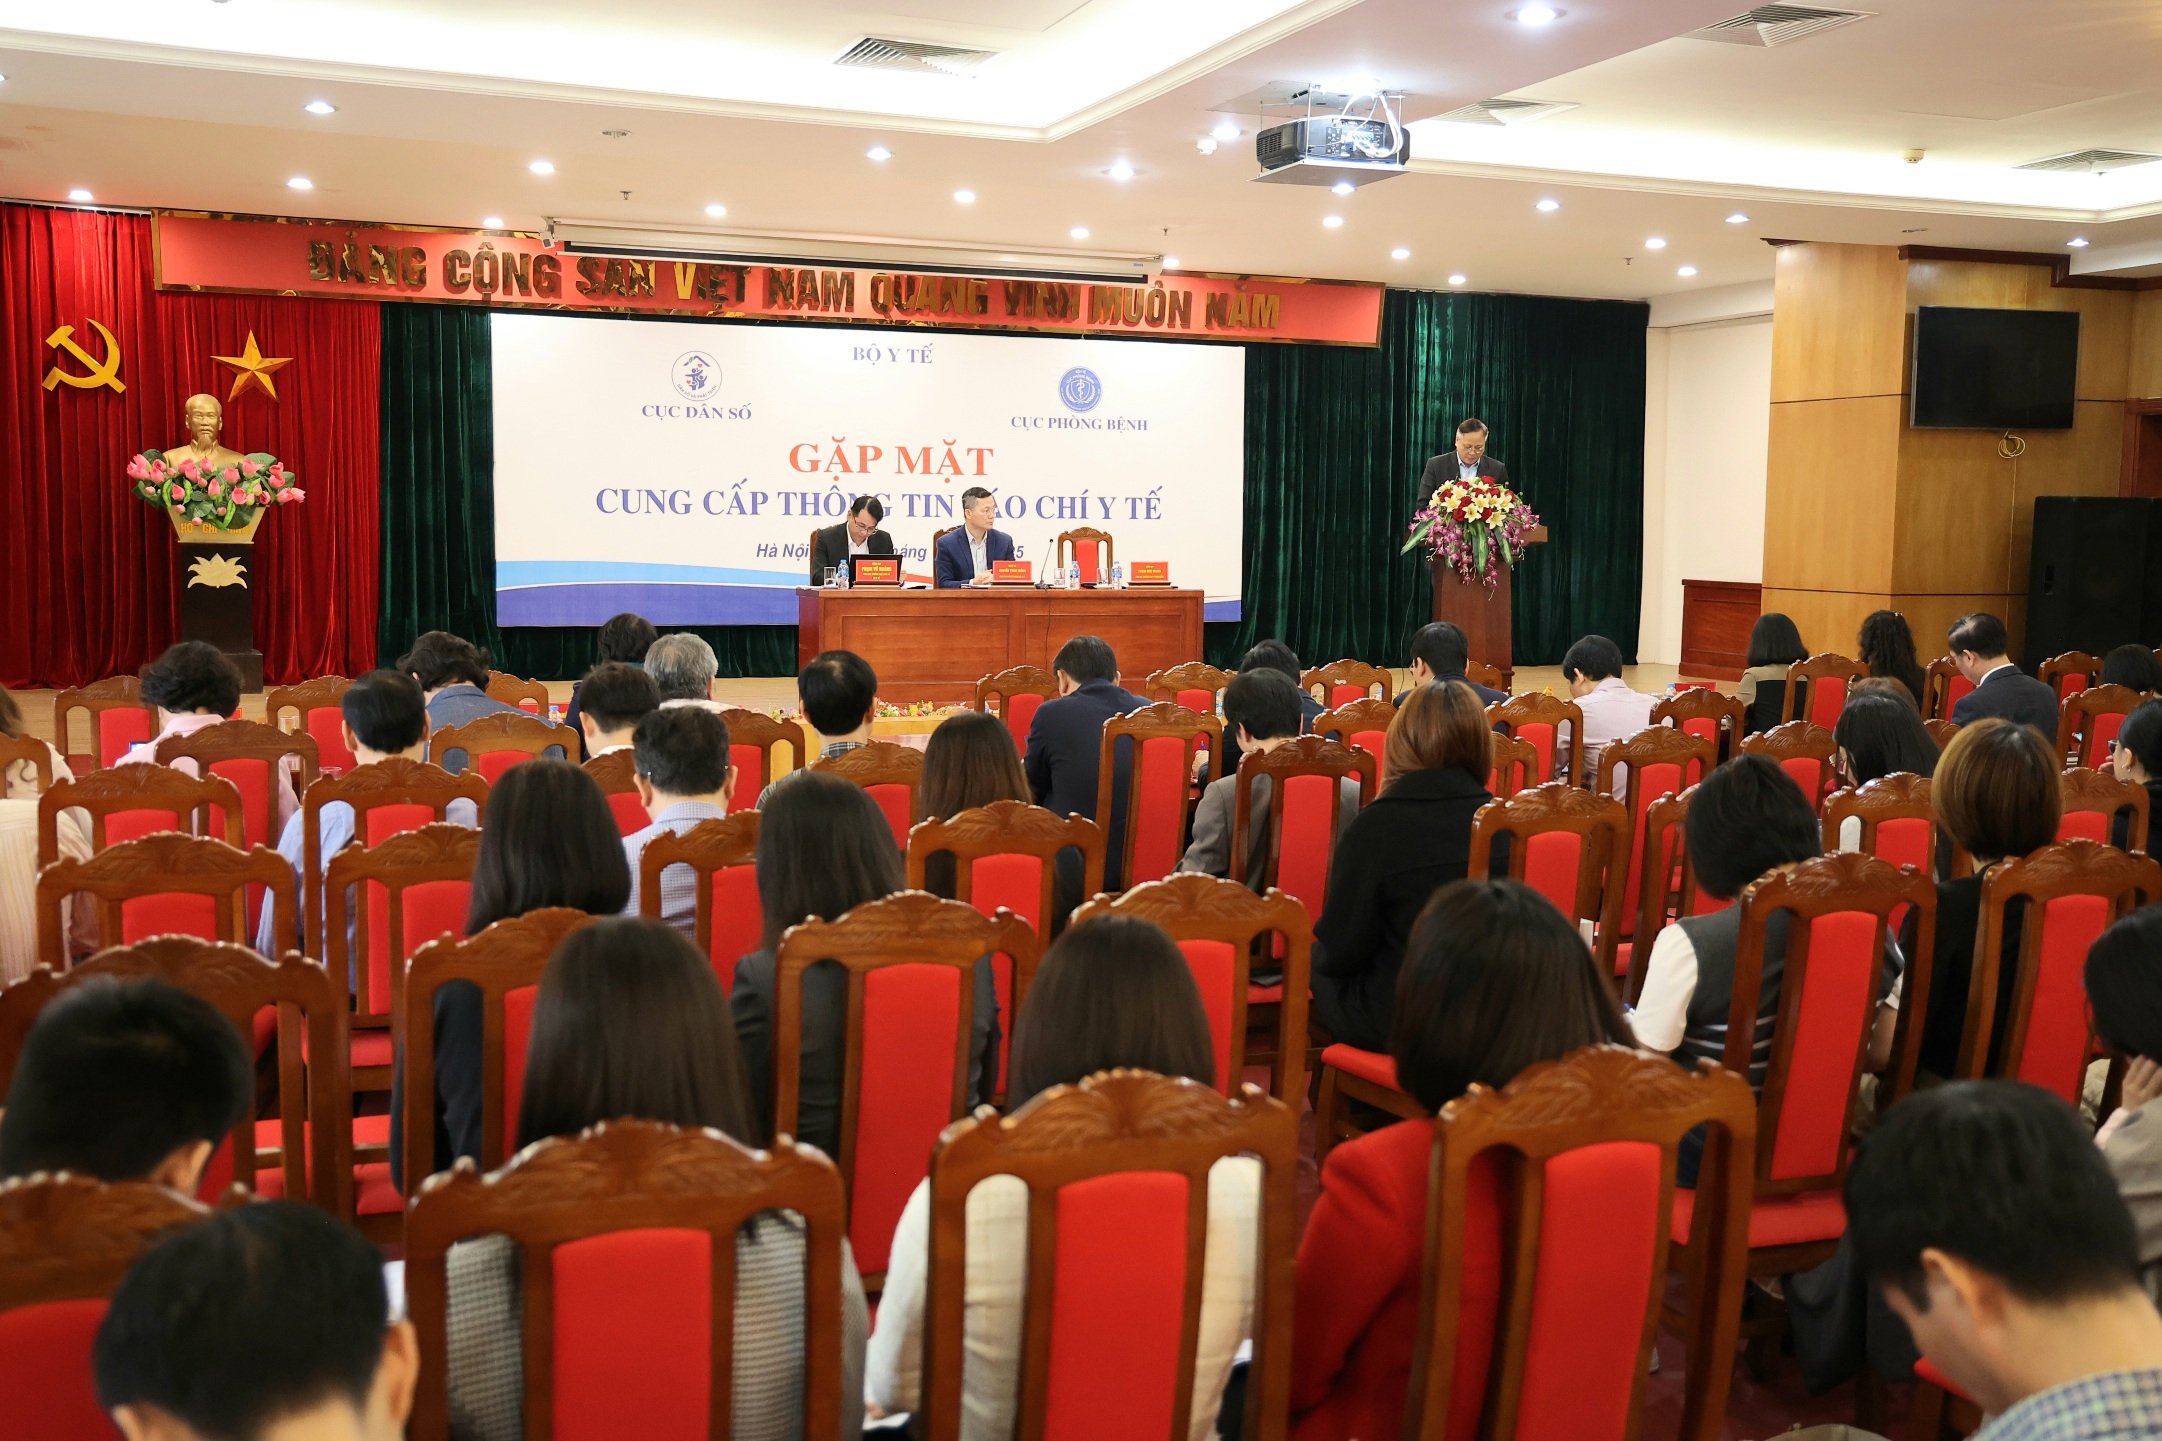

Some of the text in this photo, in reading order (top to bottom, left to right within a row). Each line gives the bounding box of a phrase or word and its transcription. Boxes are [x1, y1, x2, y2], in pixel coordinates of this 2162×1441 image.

[446, 242, 562, 303] CỘNG
[768, 267, 855, 312] NAM
[871, 272, 988, 315] QUANG
[1092, 281, 1192, 327] MUÔN
[853, 343, 933, 365] BỘ Y TẾ
[641, 402, 752, 420] CỤC DÂN SỐ
[1011, 415, 1148, 433] CỤC PHÒNG BỆNH
[788, 436, 994, 484] GẶP MẶT
[596, 488, 693, 515] CUNG
[702, 478, 769, 516] CẤP
[902, 493, 954, 518] TIN
[1035, 489, 1089, 519] CHÍ
[1097, 497, 1117, 519] Y
[1125, 485, 1163, 520] TẾ
[756, 543, 778, 558] Hà
